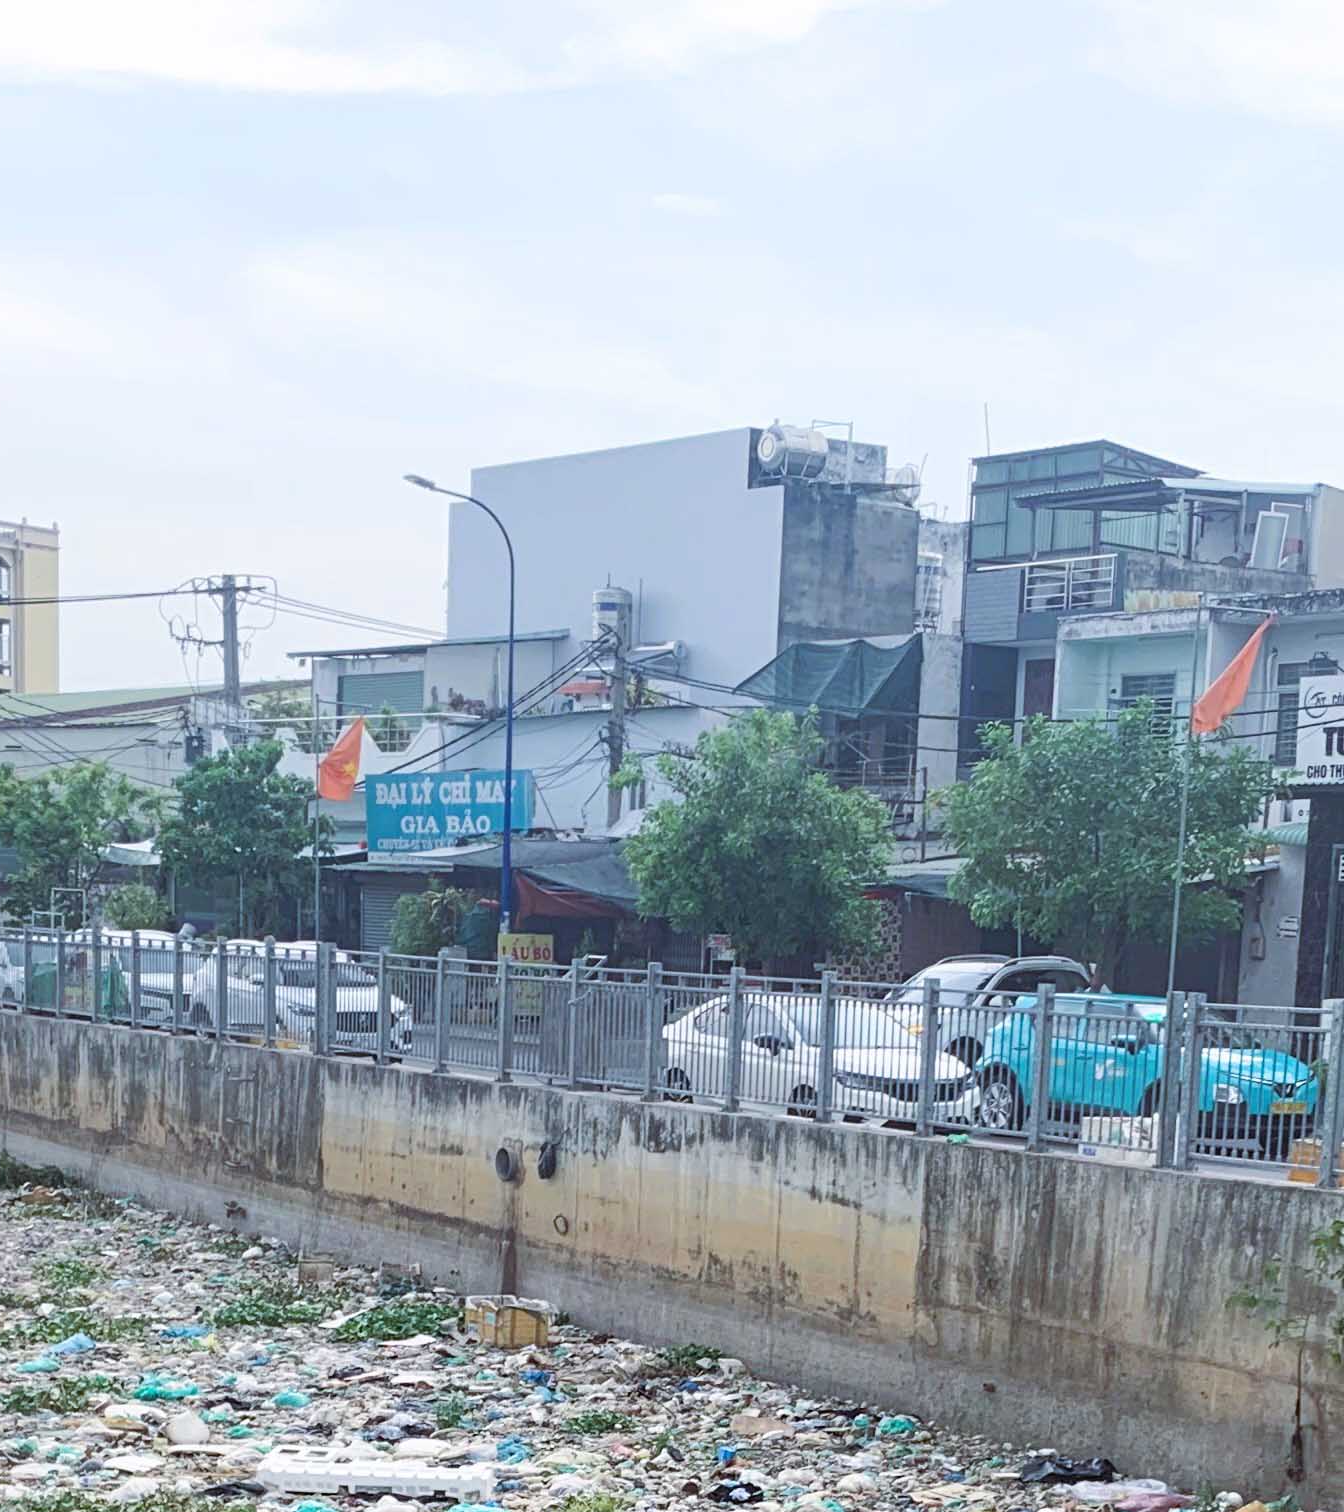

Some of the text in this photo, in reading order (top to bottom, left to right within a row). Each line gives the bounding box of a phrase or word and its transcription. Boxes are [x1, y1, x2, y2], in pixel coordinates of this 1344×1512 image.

[1307, 764, 1327, 779] CHO
[375, 773, 517, 809] ĐẠI LÝ CHỈ MAY
[400, 809, 491, 834] GIA BẢO
